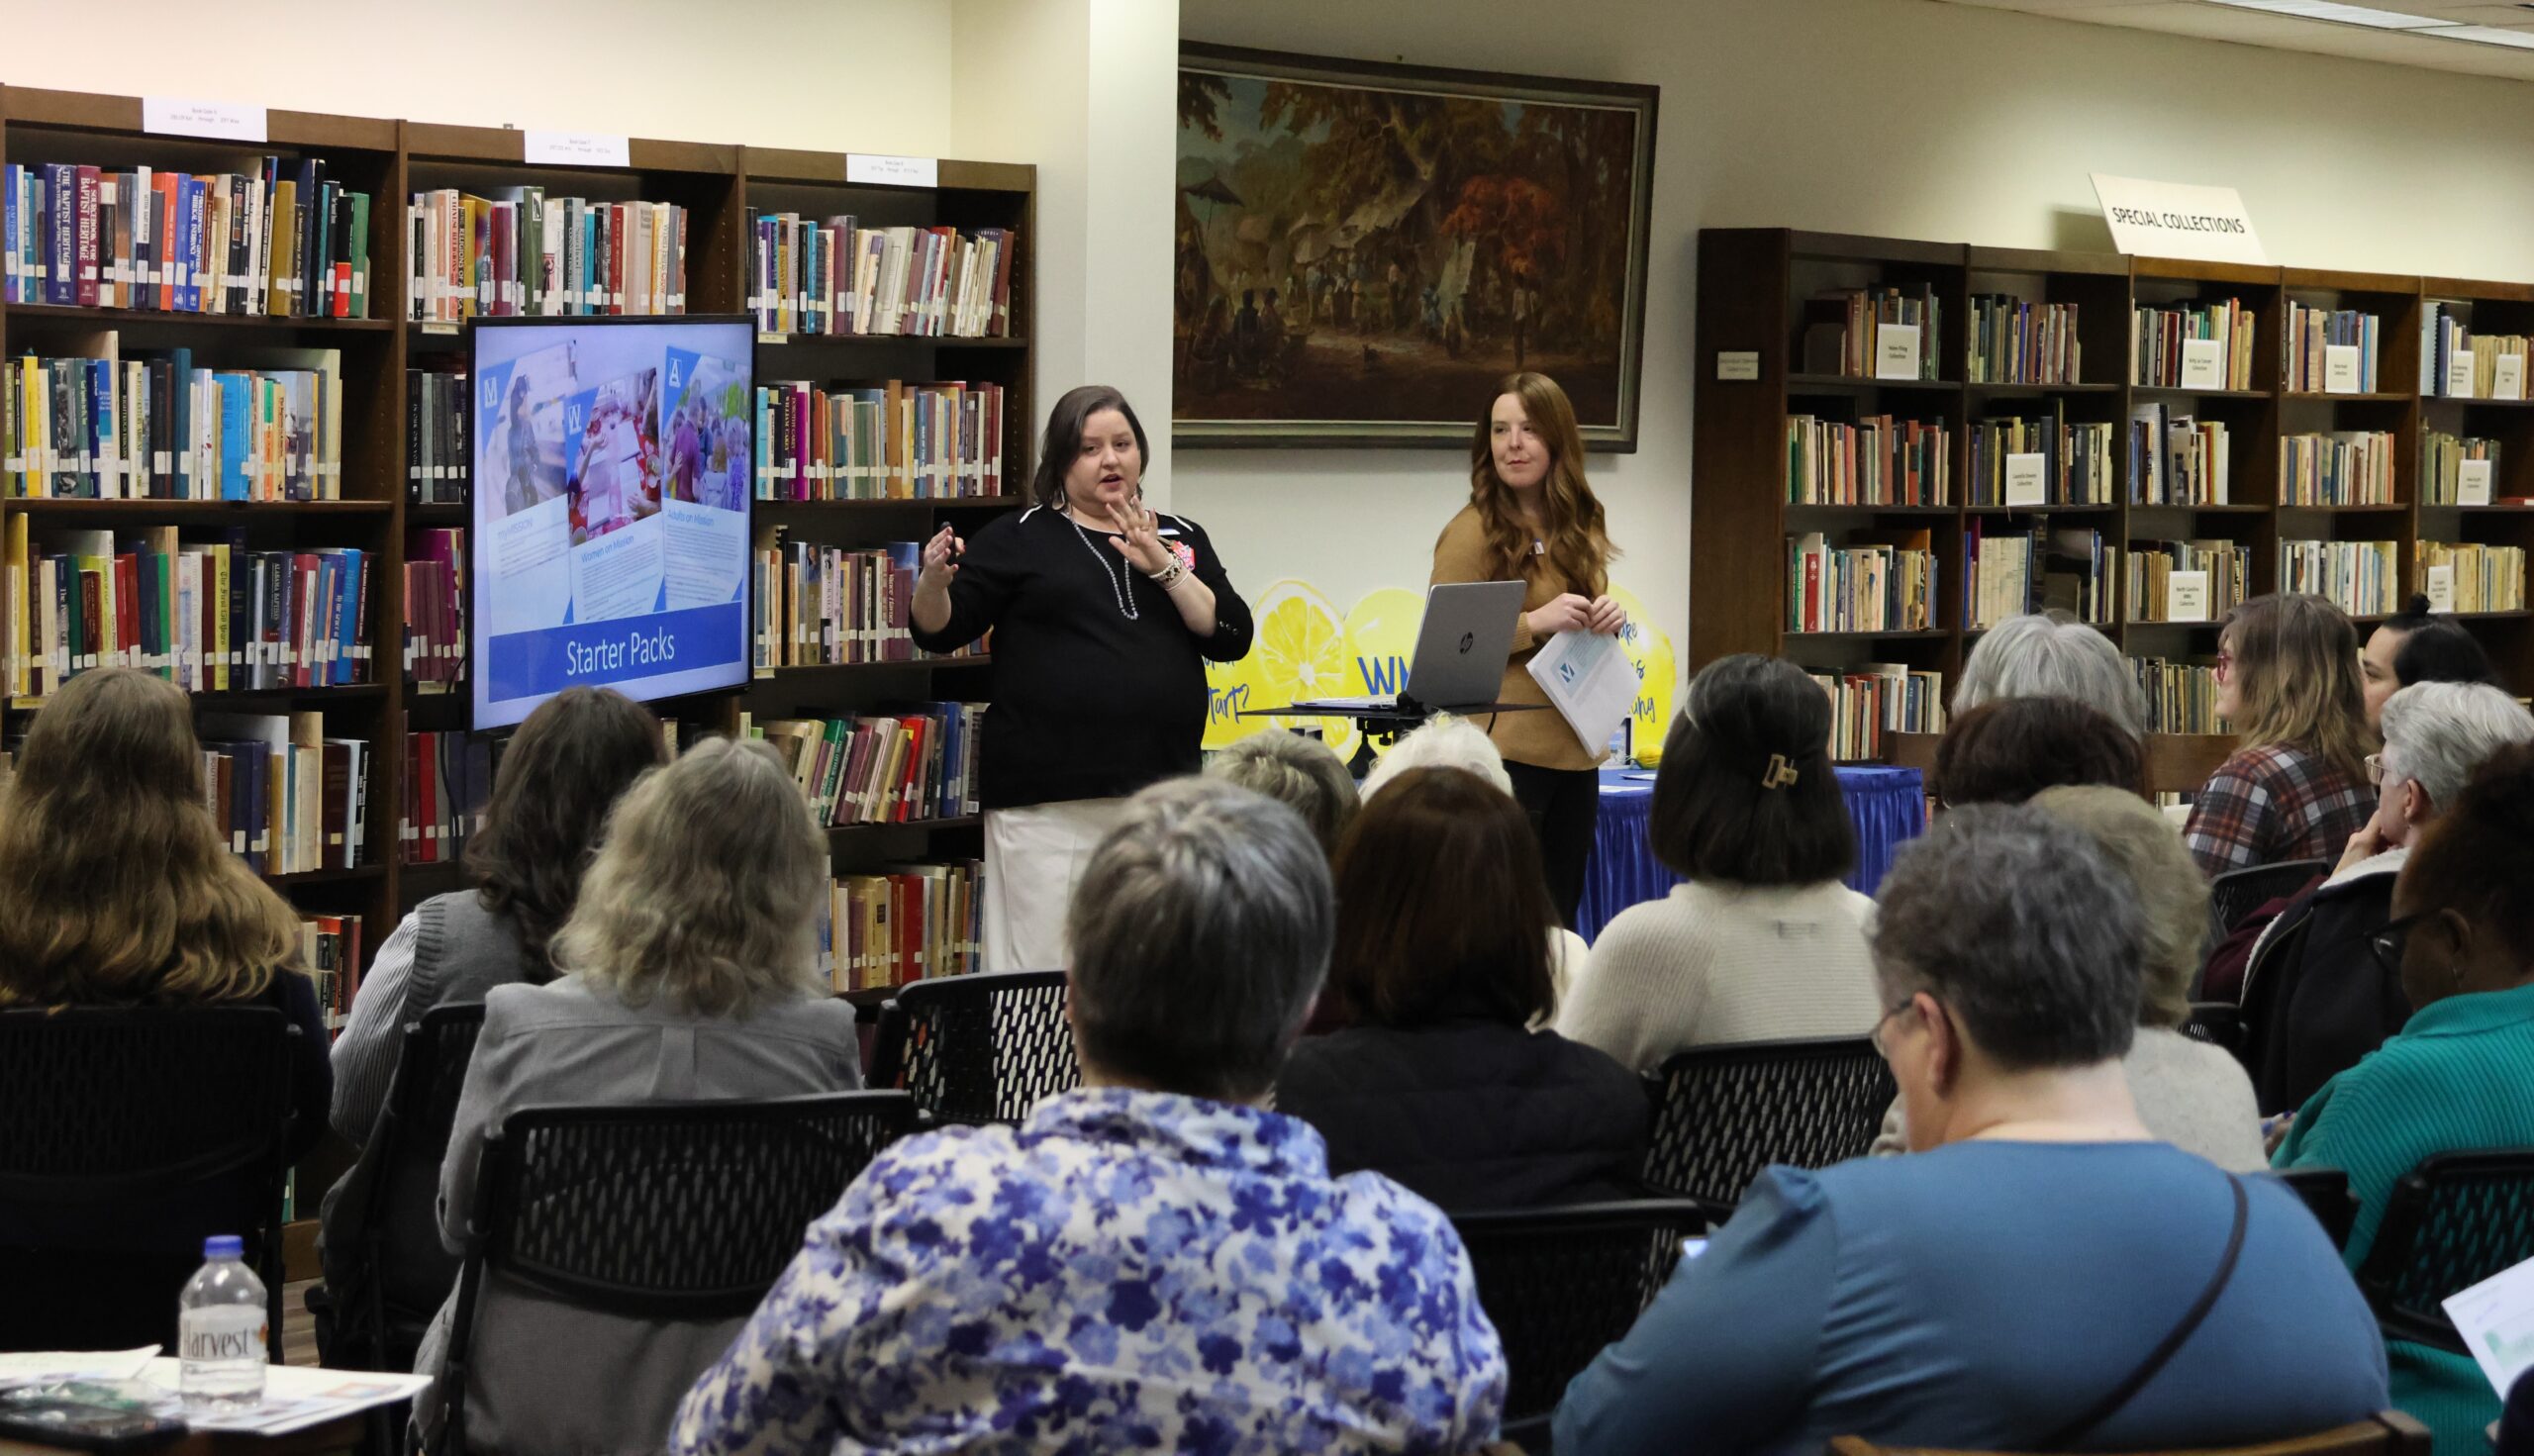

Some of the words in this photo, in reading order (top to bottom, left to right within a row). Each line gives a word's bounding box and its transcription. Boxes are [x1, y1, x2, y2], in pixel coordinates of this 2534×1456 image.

[62, 169, 71, 187] THE
[62, 190, 71, 224] BAPTIST
[80, 177, 90, 216] BAPTIST
[2112, 207, 2163, 229] SPECIAL
[2162, 213, 2246, 234] COLLECTIONS
[61, 226, 71, 265] HERITAGE
[79, 218, 90, 261] HERITAGE
[694, 514, 715, 528] Mission
[581, 546, 605, 563] Women
[613, 534, 634, 551] Mission
[567, 638, 626, 676] Starter
[631, 626, 675, 668] Packs
[1208, 682, 1250, 726] tart?
[183, 1327, 249, 1359] Harvest
